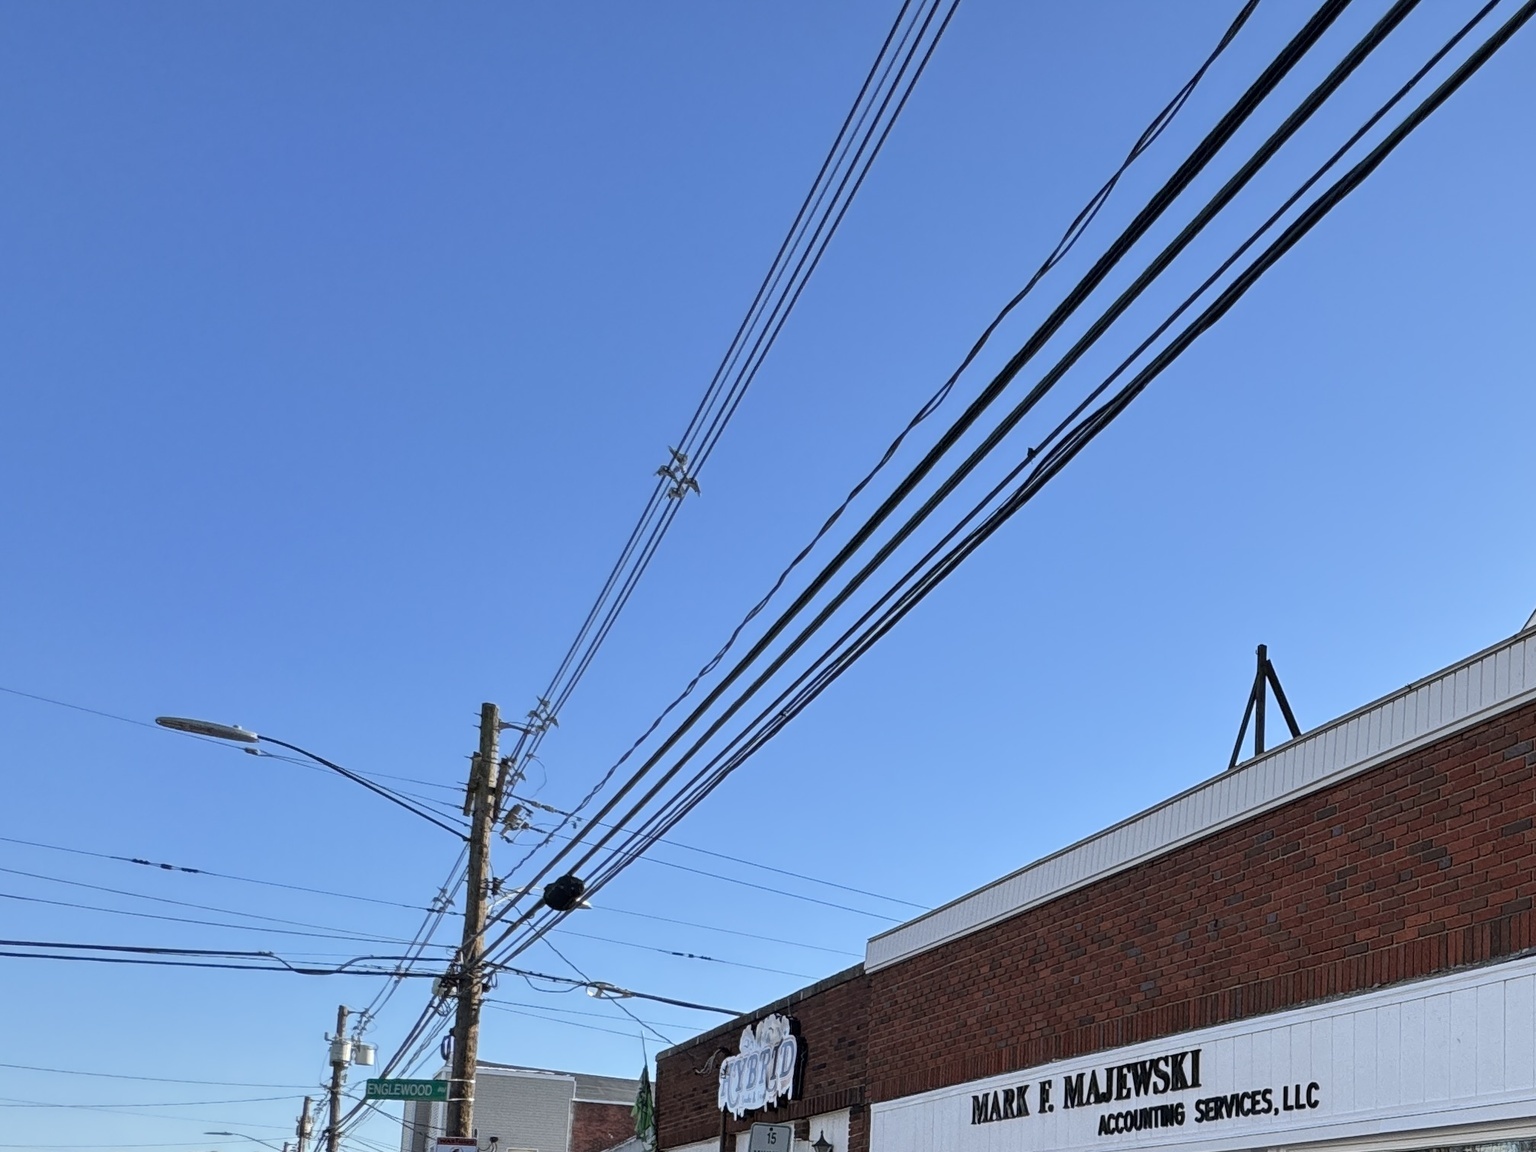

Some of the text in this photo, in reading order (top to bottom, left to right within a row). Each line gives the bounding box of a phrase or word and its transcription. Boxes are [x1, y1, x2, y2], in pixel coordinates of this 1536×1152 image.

[367, 1083, 433, 1096] ENGLEWOOD
[970, 1048, 1202, 1125] MARK F. MAJEWSKI
[1098, 1081, 1320, 1136] ACCOUNTING SERVICES, LLC
[767, 1132, 777, 1145] 15
